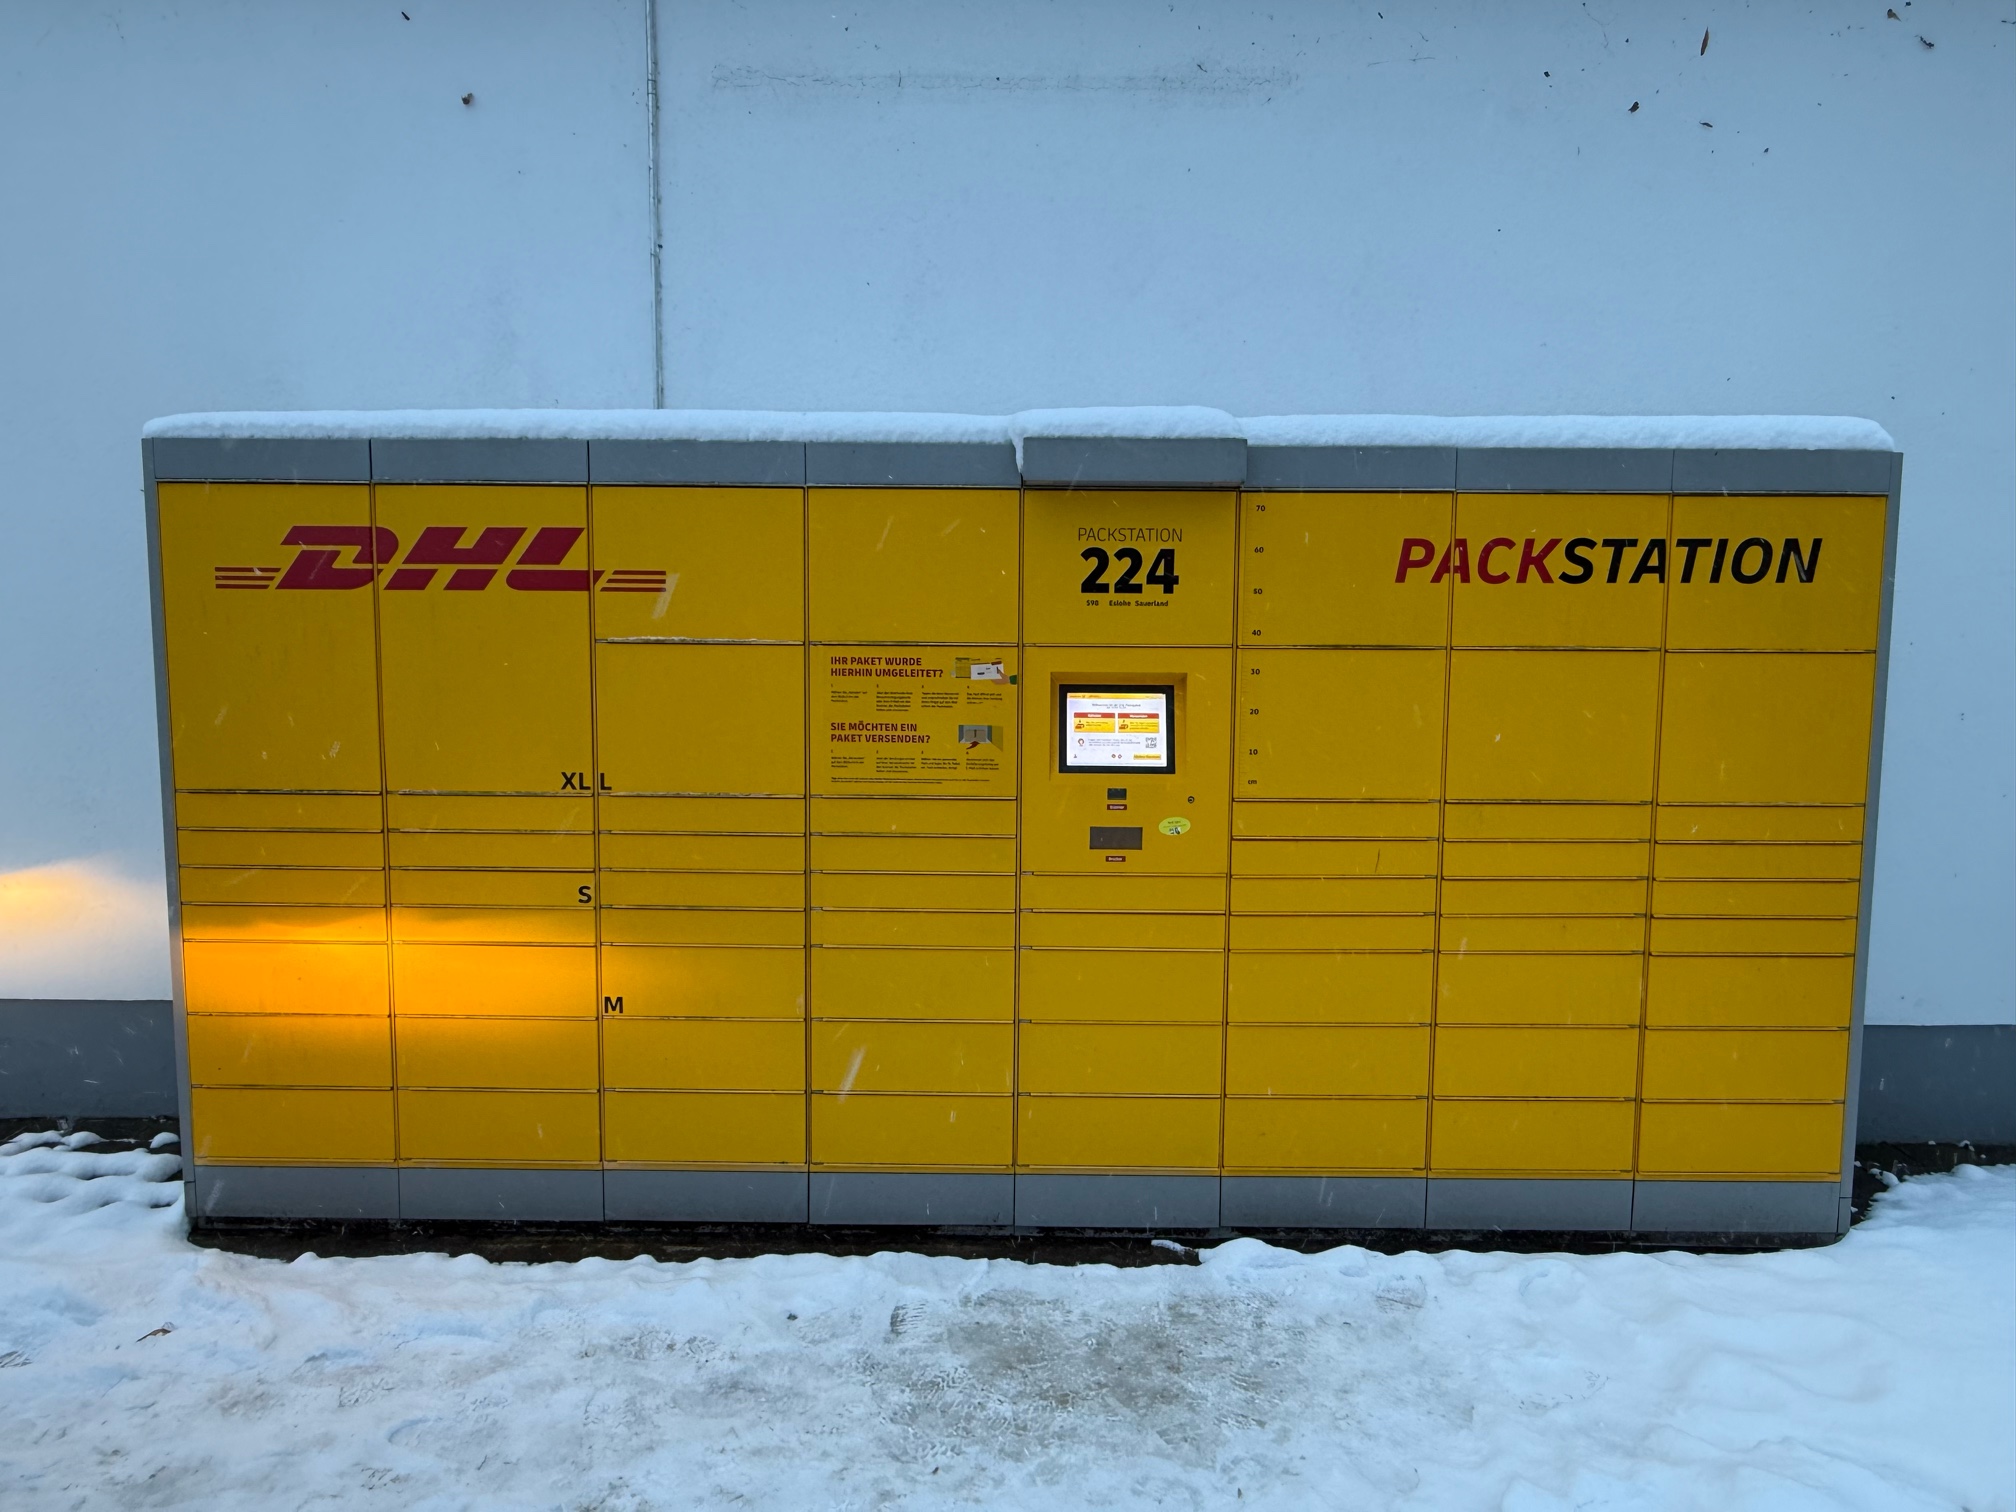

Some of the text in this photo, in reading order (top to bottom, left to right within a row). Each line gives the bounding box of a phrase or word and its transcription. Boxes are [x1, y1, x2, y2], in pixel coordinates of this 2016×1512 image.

[1255, 504, 1266, 512] 70
[1078, 527, 1183, 543] PACKSTATION
[1254, 546, 1265, 554] 60
[274, 525, 605, 591] DHL
[1395, 537, 1822, 585] PACKSTATION
[1080, 546, 1180, 595] 224
[1253, 587, 1263, 595] 50
[1108, 599, 1132, 607] Eslohe
[1134, 599, 1169, 607] Sauerland
[1251, 629, 1262, 637] 40
[830, 656, 922, 666] IHR PAKET WURDE
[830, 668, 944, 678] HIERHIN UMGELEITET?
[1250, 668, 1261, 676] 30
[1249, 708, 1260, 716] 20
[830, 720, 918, 732] SIE MÖCHTEN EIN
[830, 733, 931, 744] PAKET VERSENDEN?
[1248, 748, 1259, 756] 10
[560, 771, 591, 791] XL
[599, 772, 613, 791] L
[578, 885, 592, 904] S
[604, 996, 624, 1014] M
